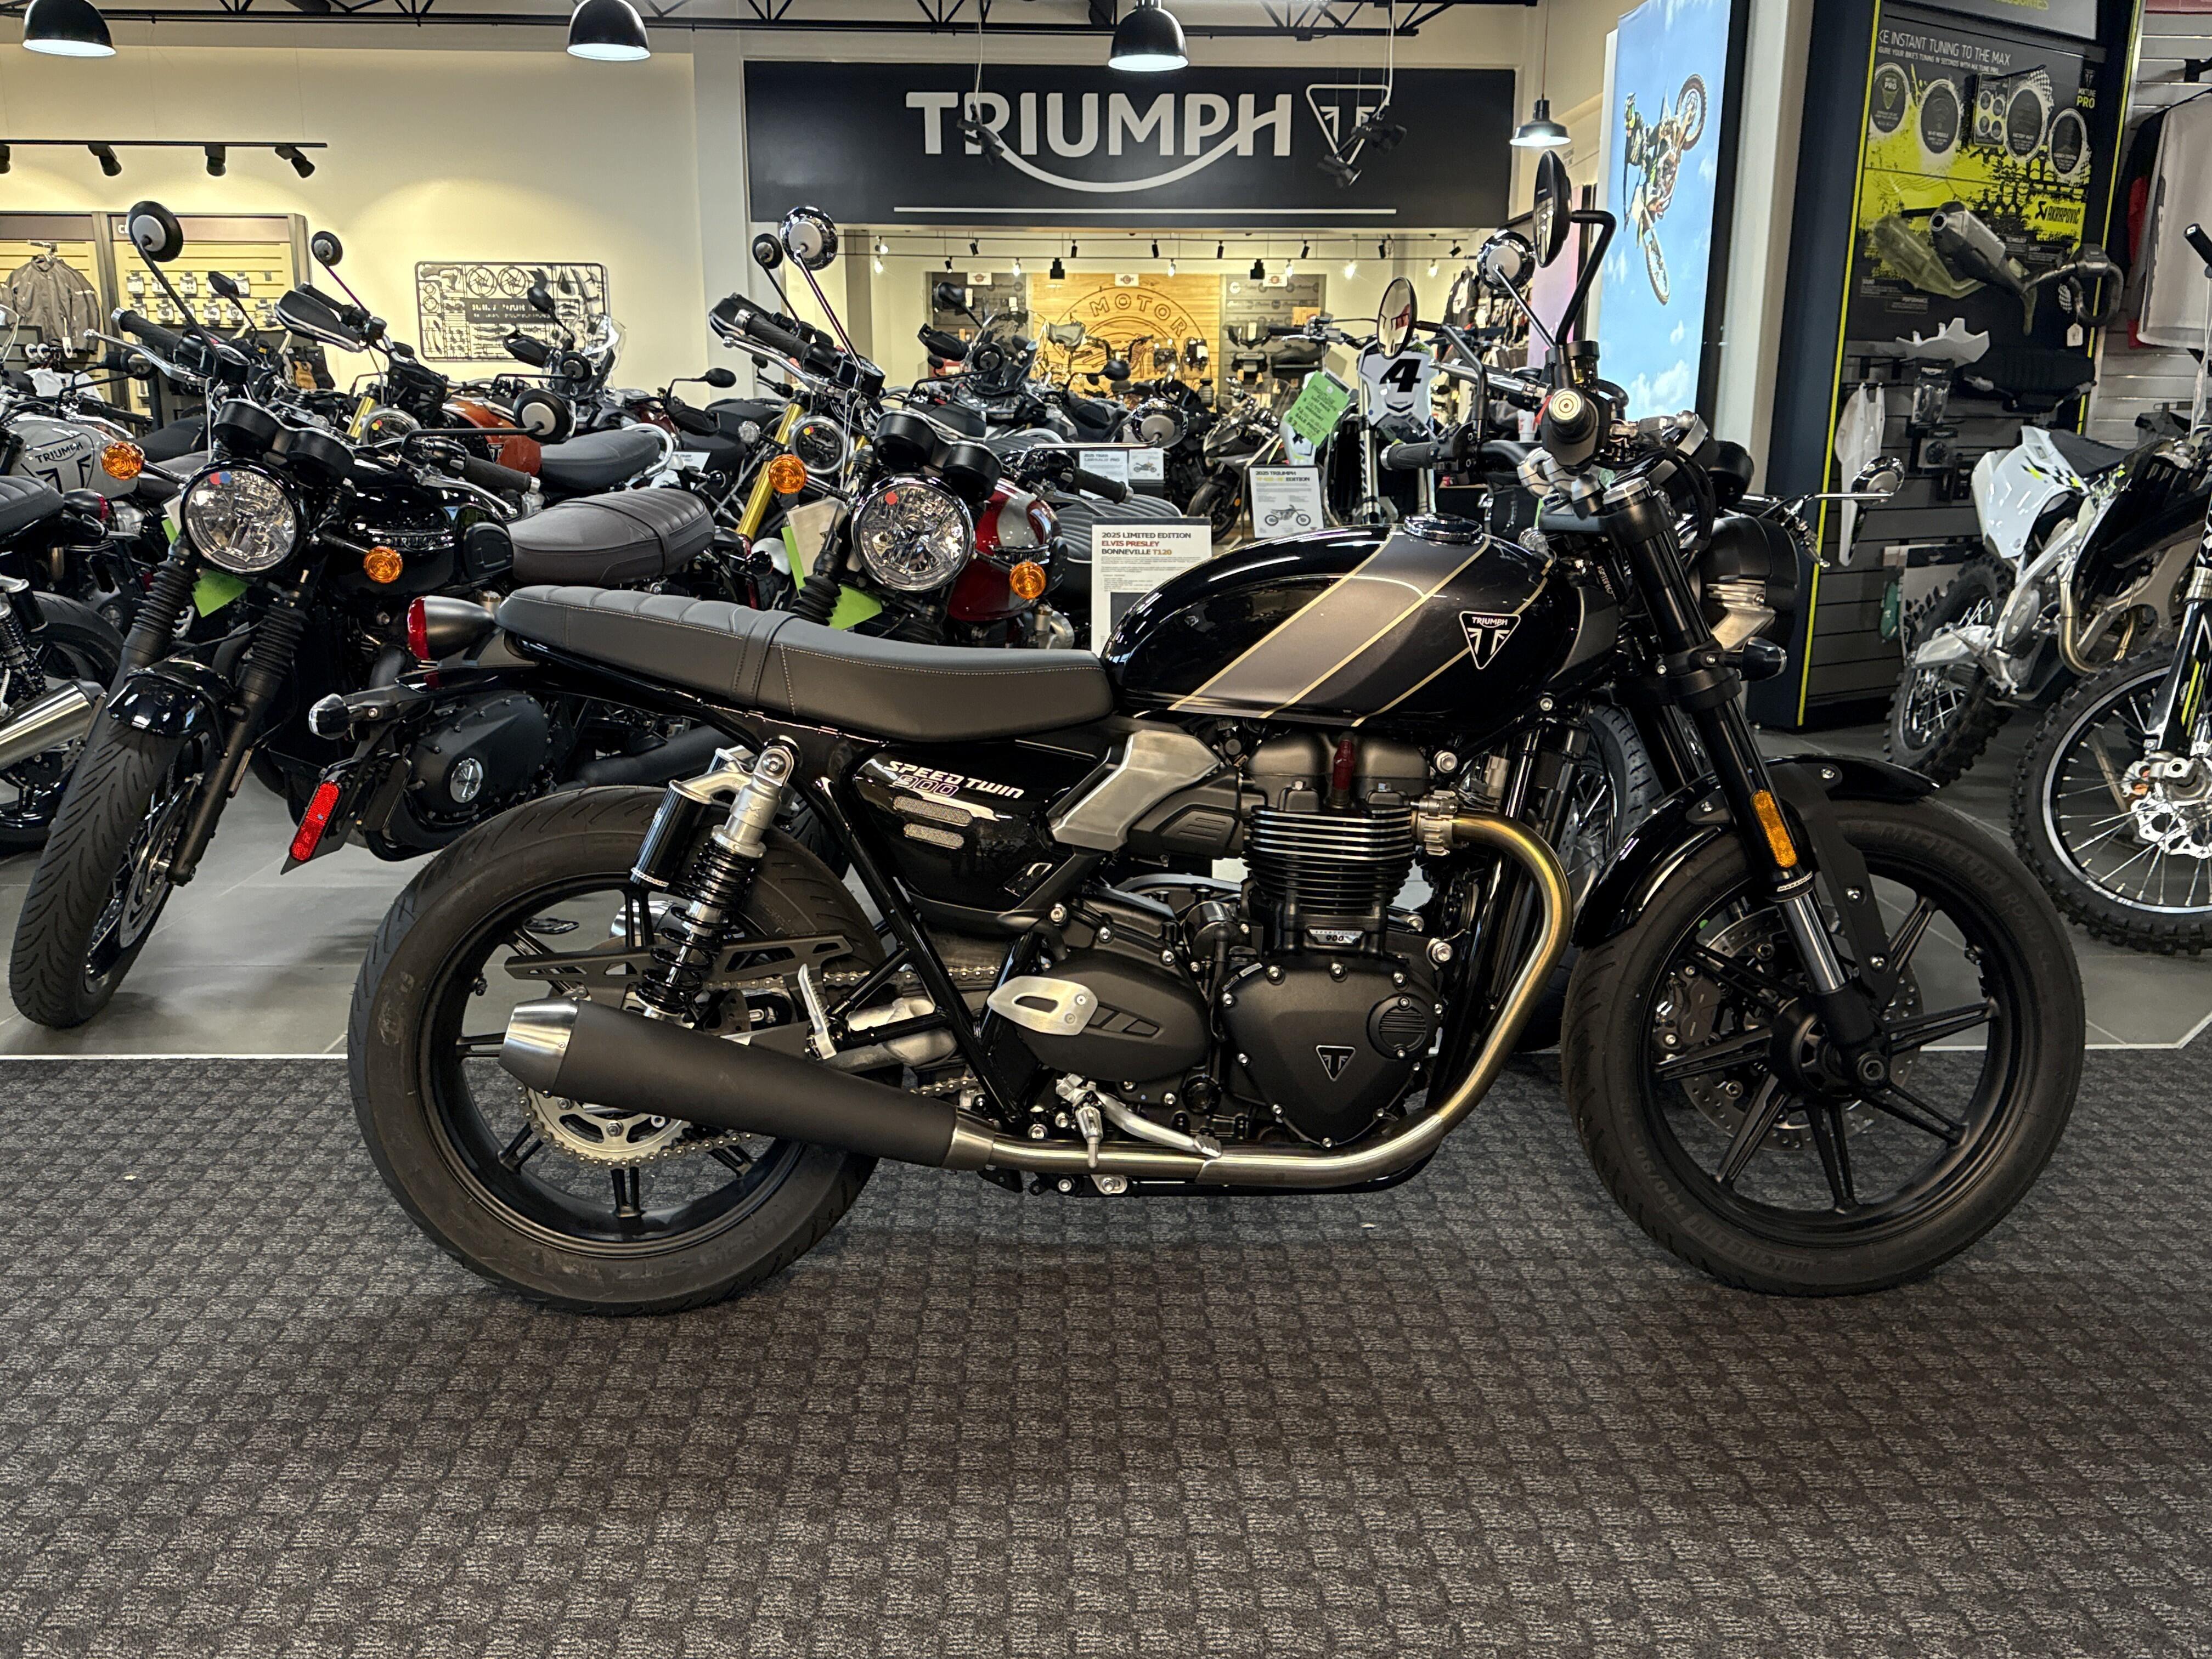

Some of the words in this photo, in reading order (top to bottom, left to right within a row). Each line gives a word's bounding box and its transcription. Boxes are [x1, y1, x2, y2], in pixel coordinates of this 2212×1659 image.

[1891, 32, 1927, 50] INSTANT
[1929, 38, 1959, 57] TUNING
[1962, 45, 1972, 59] TO
[1974, 47, 1990, 63] THE
[1992, 52, 2011, 66] MAX
[2076, 95, 2095, 109] PRO
[906, 92, 1291, 192] TRIUMPH
[1089, 293, 1187, 337] MOTOR
[1379, 359, 1422, 392] 4
[35, 442, 83, 463] TRIUMPH
[1472, 617, 1508, 628] TRIUMPH
[884, 760, 964, 785] SPEED
[964, 777, 1024, 799] TWIN
[893, 774, 960, 797] 900
